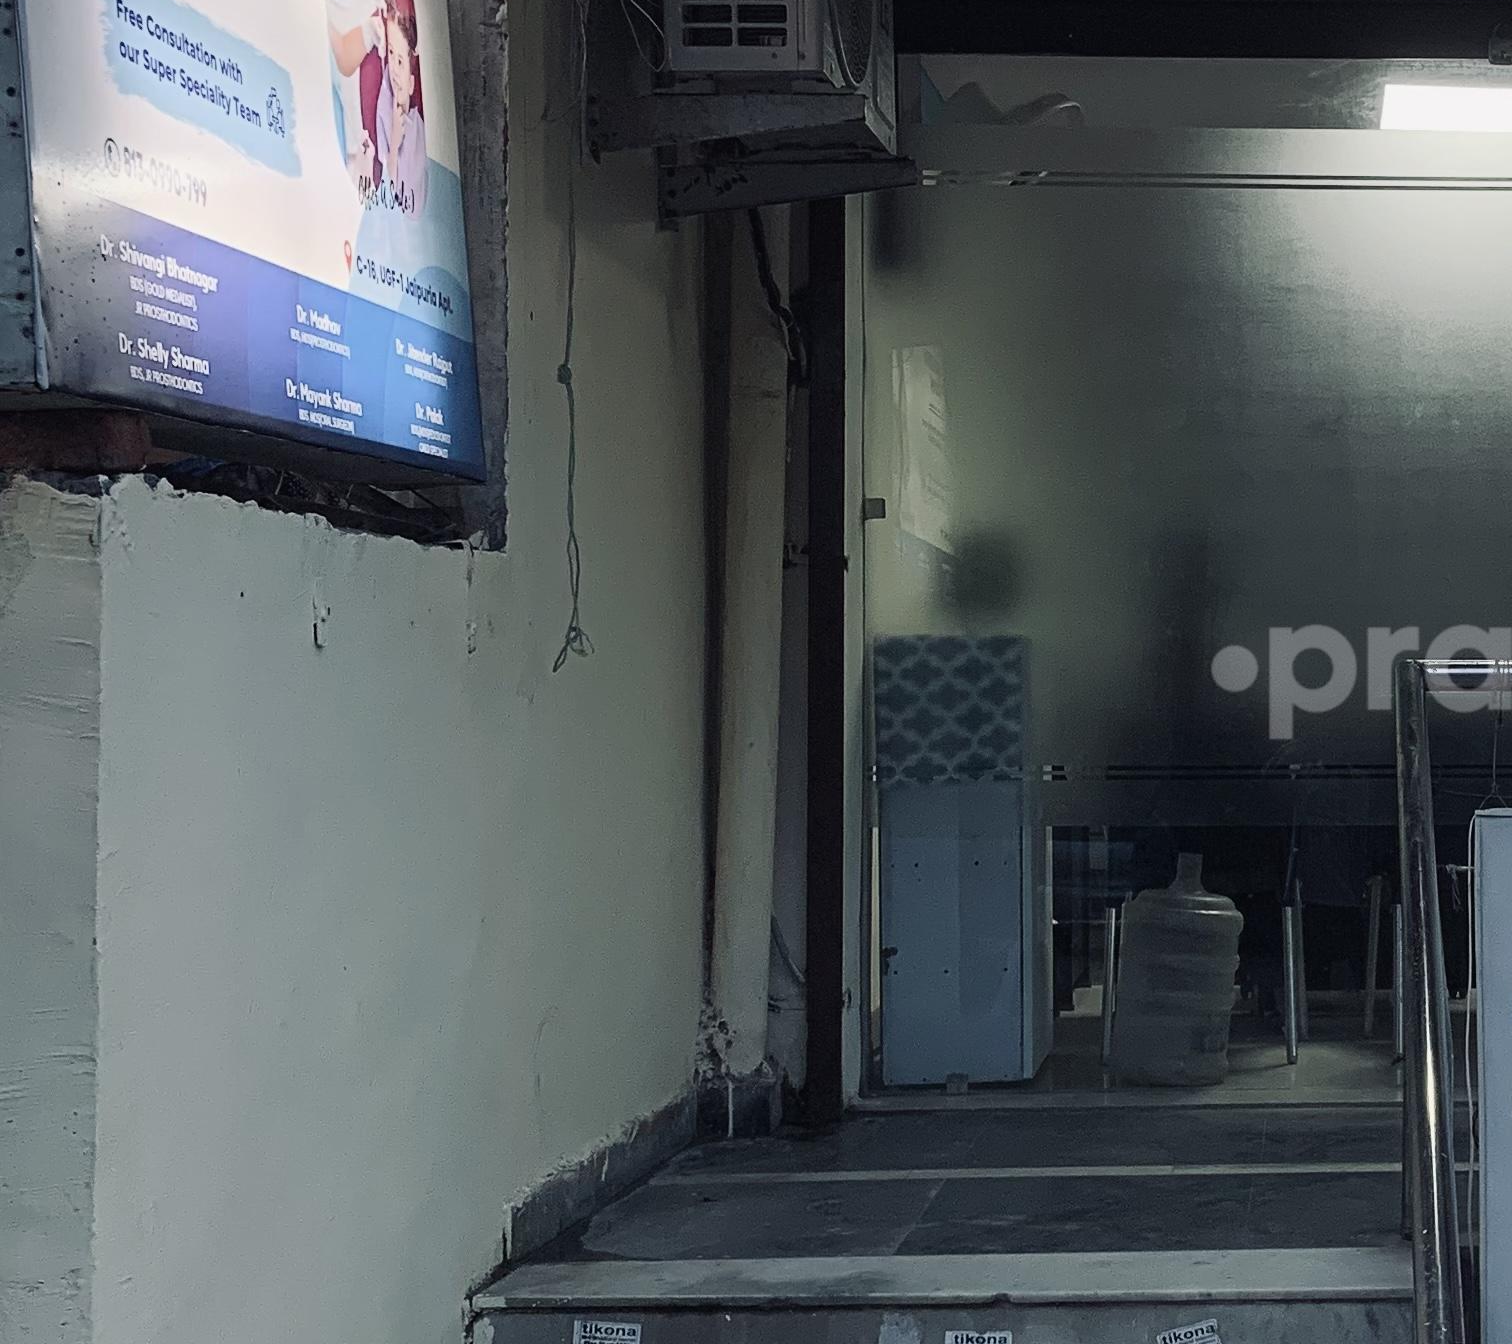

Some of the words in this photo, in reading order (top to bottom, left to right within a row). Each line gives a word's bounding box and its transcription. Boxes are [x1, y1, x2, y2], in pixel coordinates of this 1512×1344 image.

[145, 14, 218, 72] Consultation
[219, 58, 244, 86] with
[119, 40, 140, 65] our
[142, 47, 178, 83] Super
[178, 67, 232, 117] Speciality
[232, 95, 263, 129] Team
[100, 234, 119, 260] Dr.
[118, 240, 167, 280] Shivangi
[166, 256, 219, 295] Bhatnagar
[295, 304, 310, 327] Dr.
[118, 332, 138, 357] Dr.
[136, 337, 171, 370] Shelly
[170, 346, 211, 377] Sharma
[285, 377, 301, 401] Dr.
[299, 382, 334, 410] Mayank
[332, 388, 364, 417] Sharma
[583, 1323, 637, 1337] tikona
[954, 1333, 1008, 1344] tikona
